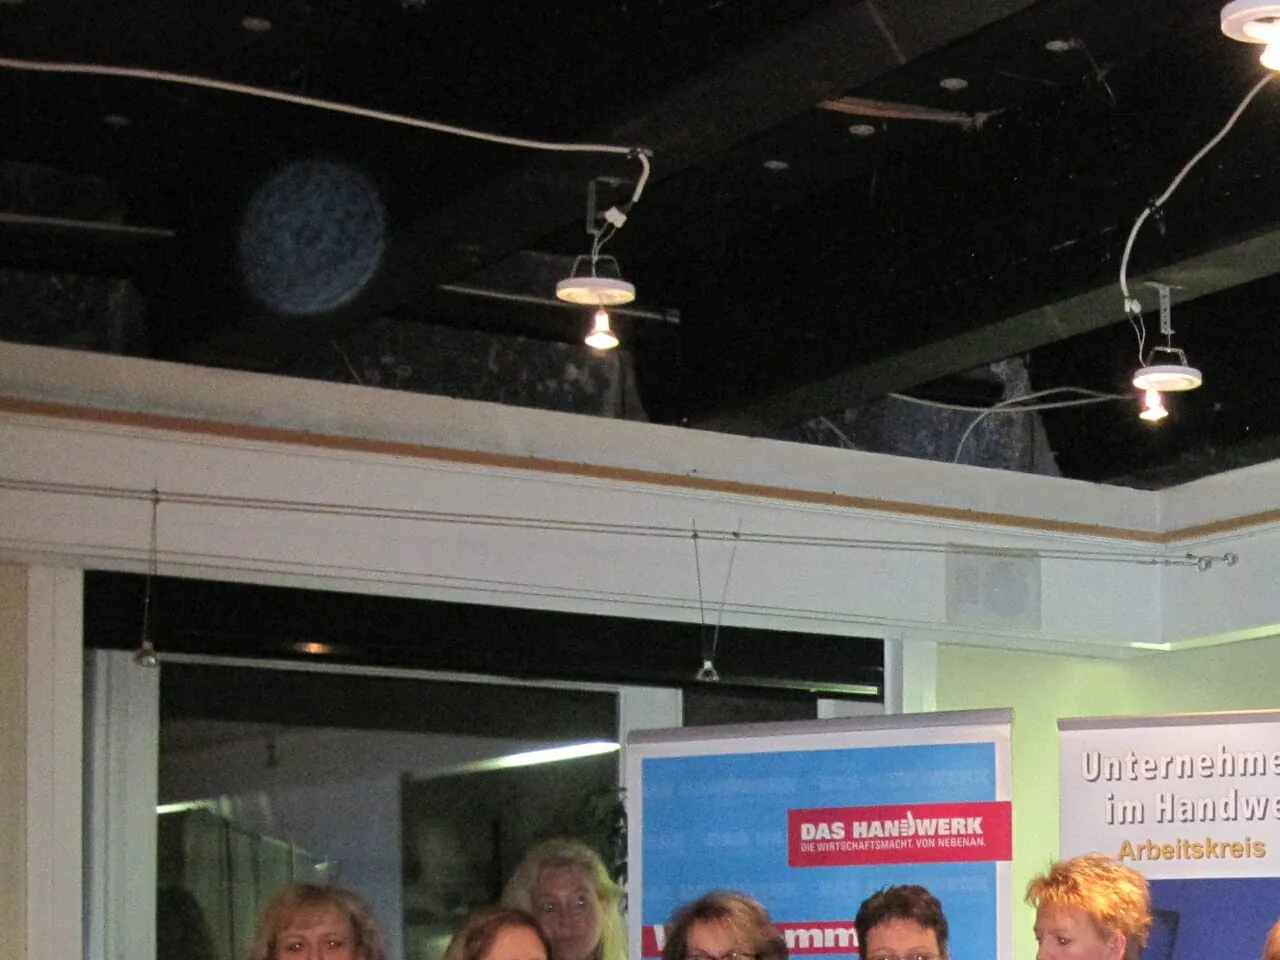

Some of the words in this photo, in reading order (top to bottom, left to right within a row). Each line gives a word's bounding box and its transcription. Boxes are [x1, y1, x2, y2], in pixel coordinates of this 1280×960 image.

[1104, 792, 1145, 825] im
[800, 822, 845, 840] DAS
[852, 812, 984, 839] HANDWERK
[800, 843, 815, 853] DIE
[915, 838, 936, 849] VON
[938, 837, 986, 849] NEBENAN.
[1118, 836, 1266, 861] Arbeitskreis
